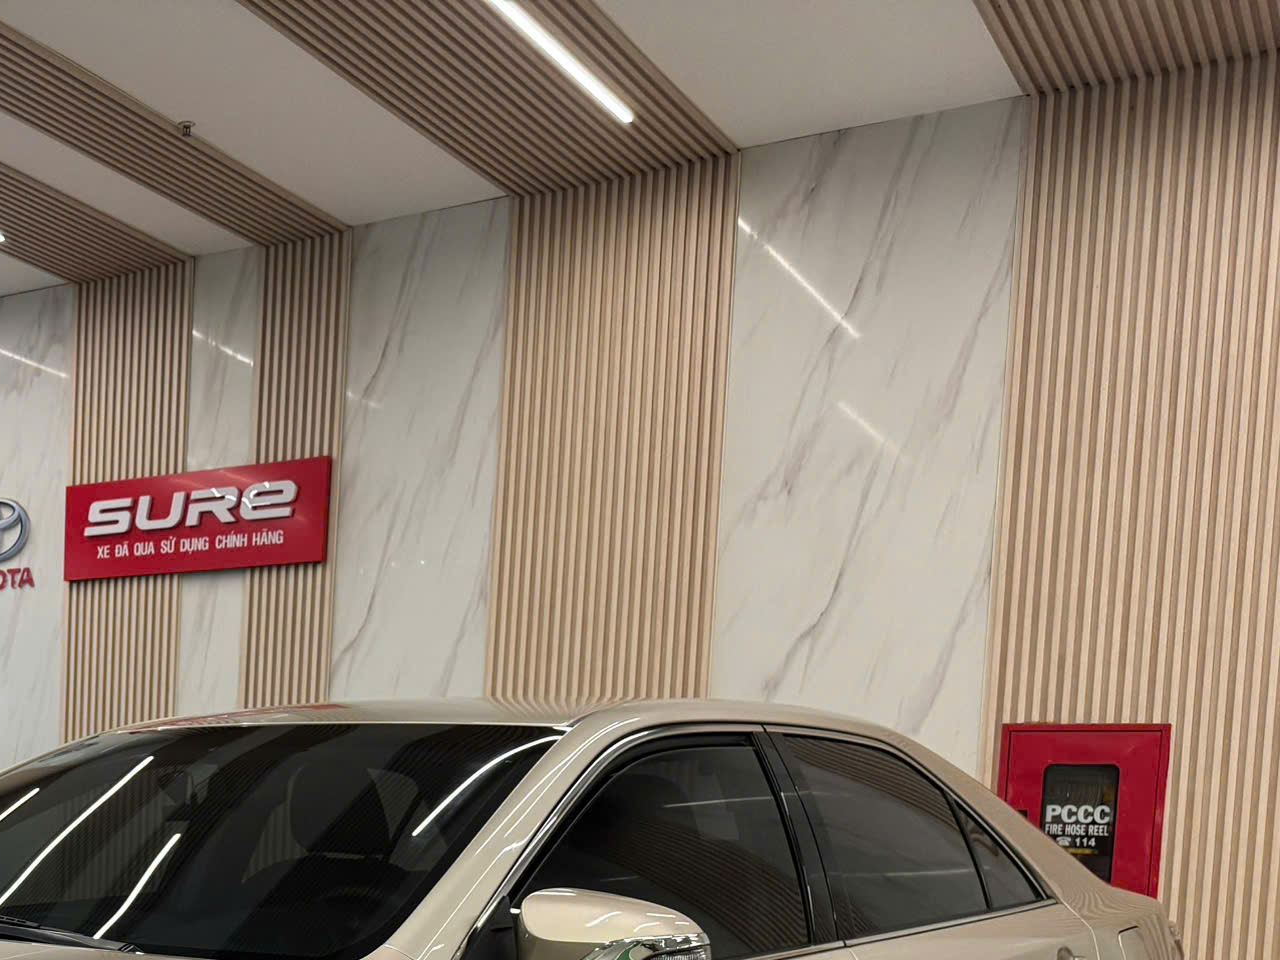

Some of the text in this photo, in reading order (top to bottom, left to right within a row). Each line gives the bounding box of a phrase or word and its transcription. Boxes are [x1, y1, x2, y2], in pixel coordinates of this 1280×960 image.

[97, 545, 110, 559] XE
[115, 541, 129, 558] ĐÃ
[134, 541, 155, 556] QUA
[180, 536, 209, 555] DỤNG
[215, 530, 248, 549] CHÍNH
[1045, 804, 1111, 824] PCCC
[1045, 823, 1109, 836] FIRE HOSE REEL
[1075, 837, 1096, 847] 114
